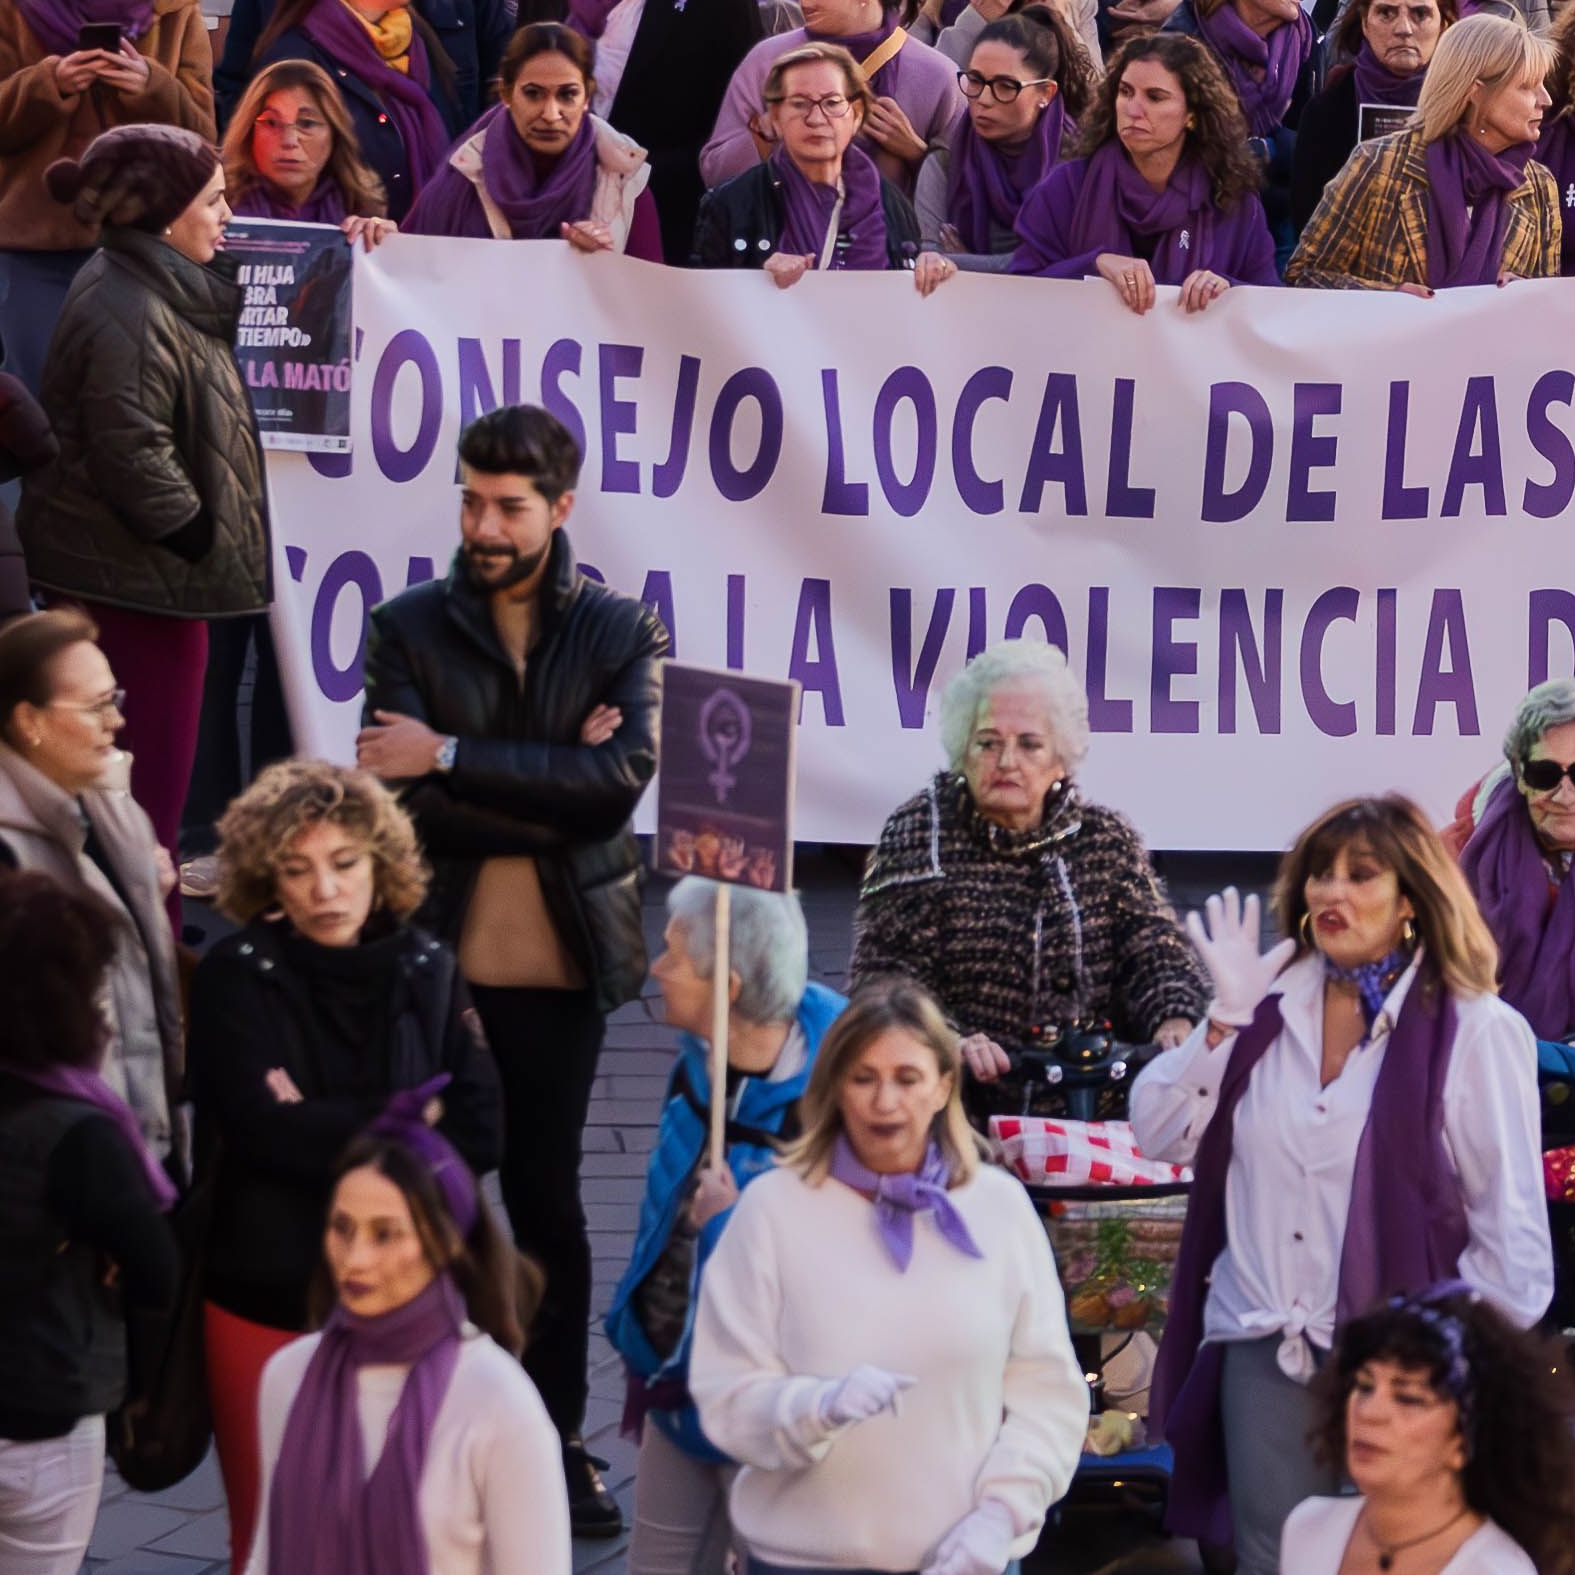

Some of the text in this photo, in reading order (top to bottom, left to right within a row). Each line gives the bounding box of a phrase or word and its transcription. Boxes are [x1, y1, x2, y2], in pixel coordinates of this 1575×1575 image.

[253, 265, 296, 286] HIJA
[244, 286, 278, 305] BRA
[239, 306, 289, 326] RTAR
[247, 358, 350, 392] LA MATÓ
[307, 328, 785, 502] ONSEJO
[821, 365, 1157, 519] LOCAL
[1201, 381, 1342, 523] DE
